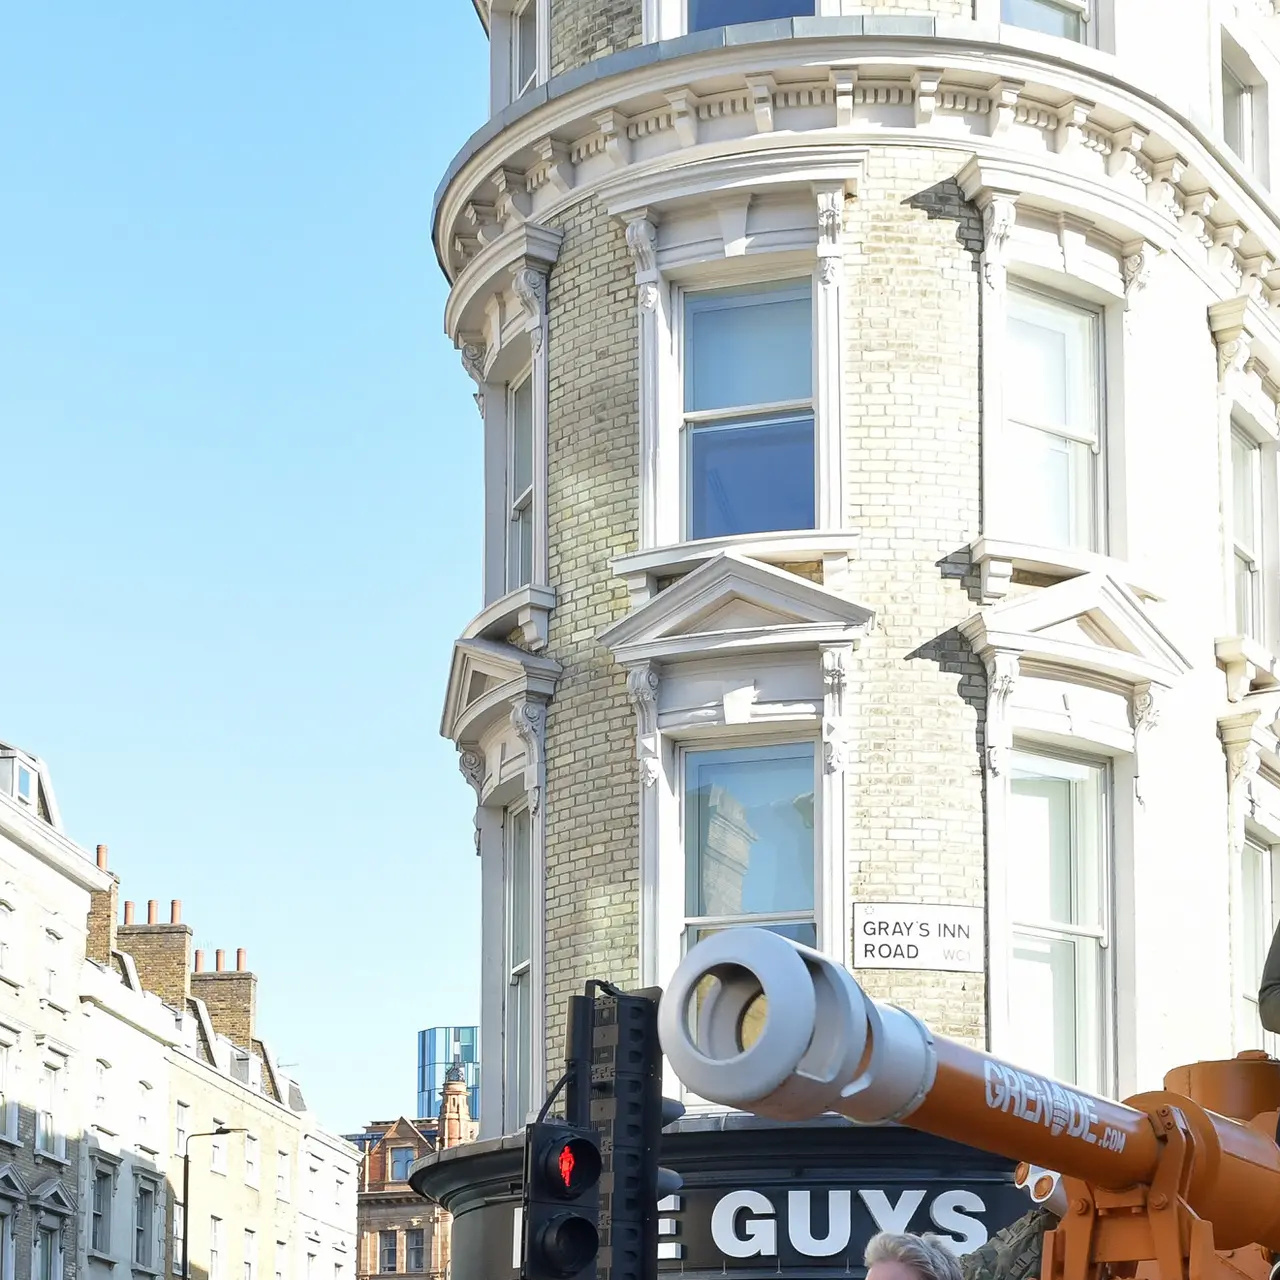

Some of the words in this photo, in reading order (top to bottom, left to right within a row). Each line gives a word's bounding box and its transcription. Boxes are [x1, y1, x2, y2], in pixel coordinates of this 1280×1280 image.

[863, 920, 930, 937] GRAY'S
[938, 923, 970, 939] INN
[864, 943, 919, 959] ROAD
[711, 1190, 988, 1258] GUYS
